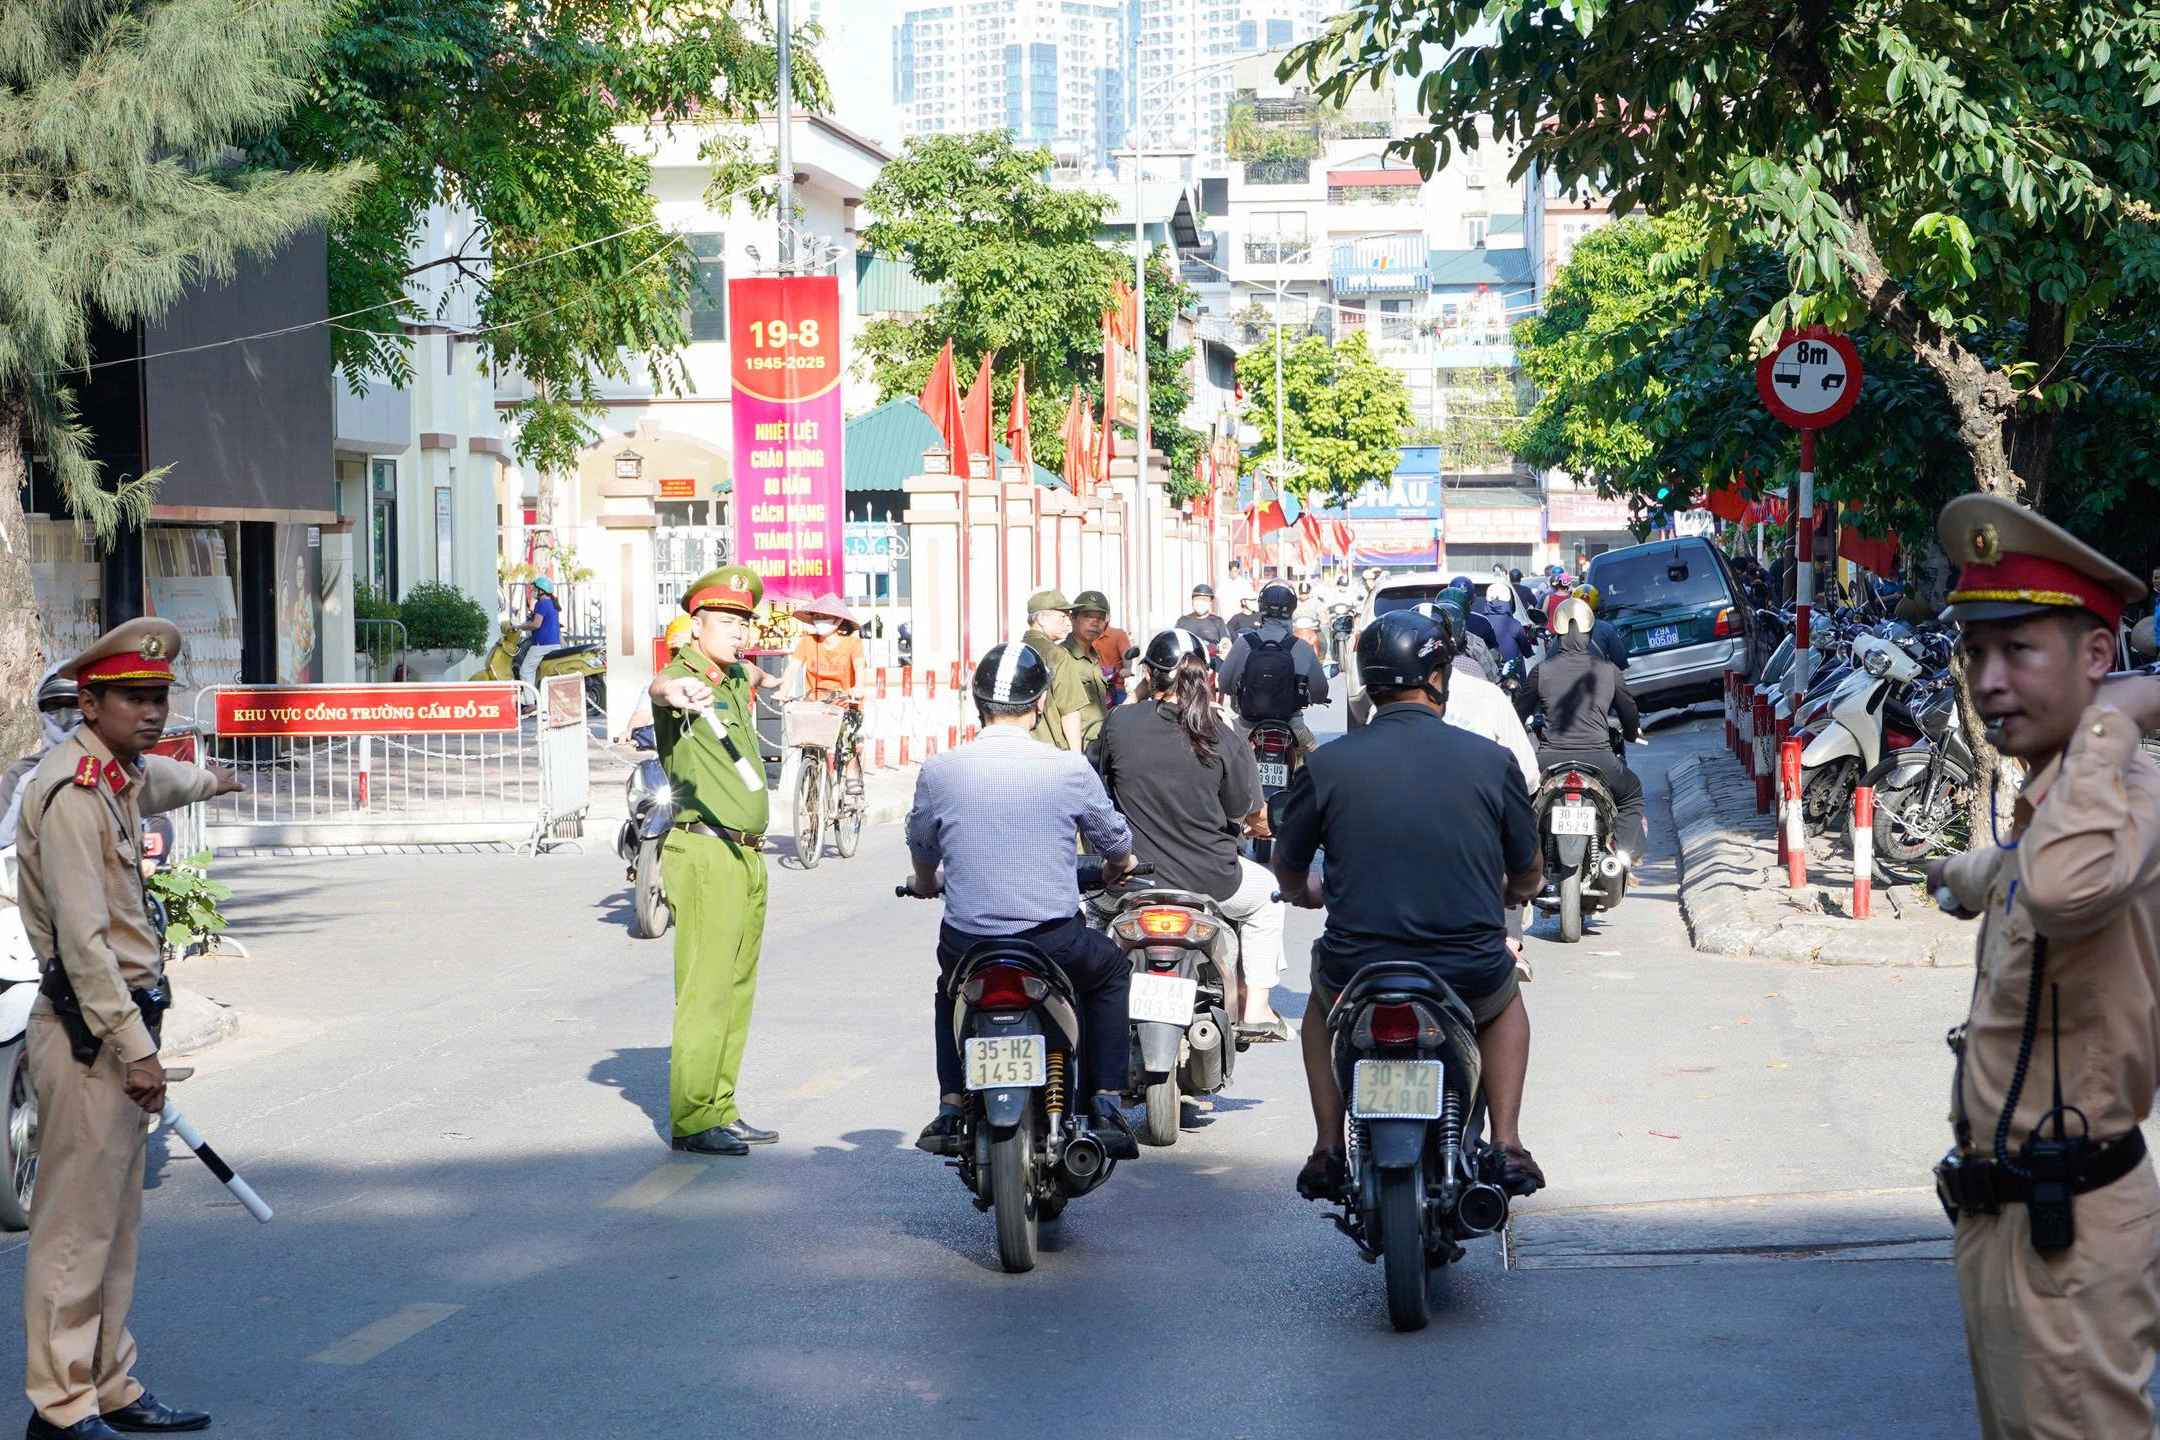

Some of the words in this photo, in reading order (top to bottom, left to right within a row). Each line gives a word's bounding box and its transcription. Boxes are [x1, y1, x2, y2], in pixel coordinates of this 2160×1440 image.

[749, 320, 820, 348] 19-8
[745, 356, 826, 370] 1945-2025
[1797, 341, 1828, 365] 8m
[755, 419, 791, 444] NHIỆT
[793, 419, 819, 444] LIỆT
[751, 447, 783, 468] CHÀO
[786, 446, 824, 468] MỪNG
[781, 474, 811, 496] NĂM
[751, 501, 784, 523] CÁCH
[787, 503, 826, 526] MẠNG
[753, 528, 793, 550] THÁNG
[797, 528, 823, 550] TÁM
[788, 555, 823, 576] CÔNG
[233, 708, 266, 722] KHU
[271, 706, 301, 723] VỰC
[304, 702, 348, 721] CỔNG
[350, 703, 415, 720] TRƯỜNG
[418, 703, 451, 719] CẤM
[454, 700, 477, 718] ĐỖ
[478, 705, 500, 719] XE
[1558, 821, 1589, 832] 8529
[977, 1039, 1033, 1061] 35-H2
[979, 1061, 1033, 1084] 1453
[1368, 1063, 1429, 1087] 30-M2
[1366, 1089, 1428, 1113] 2480
